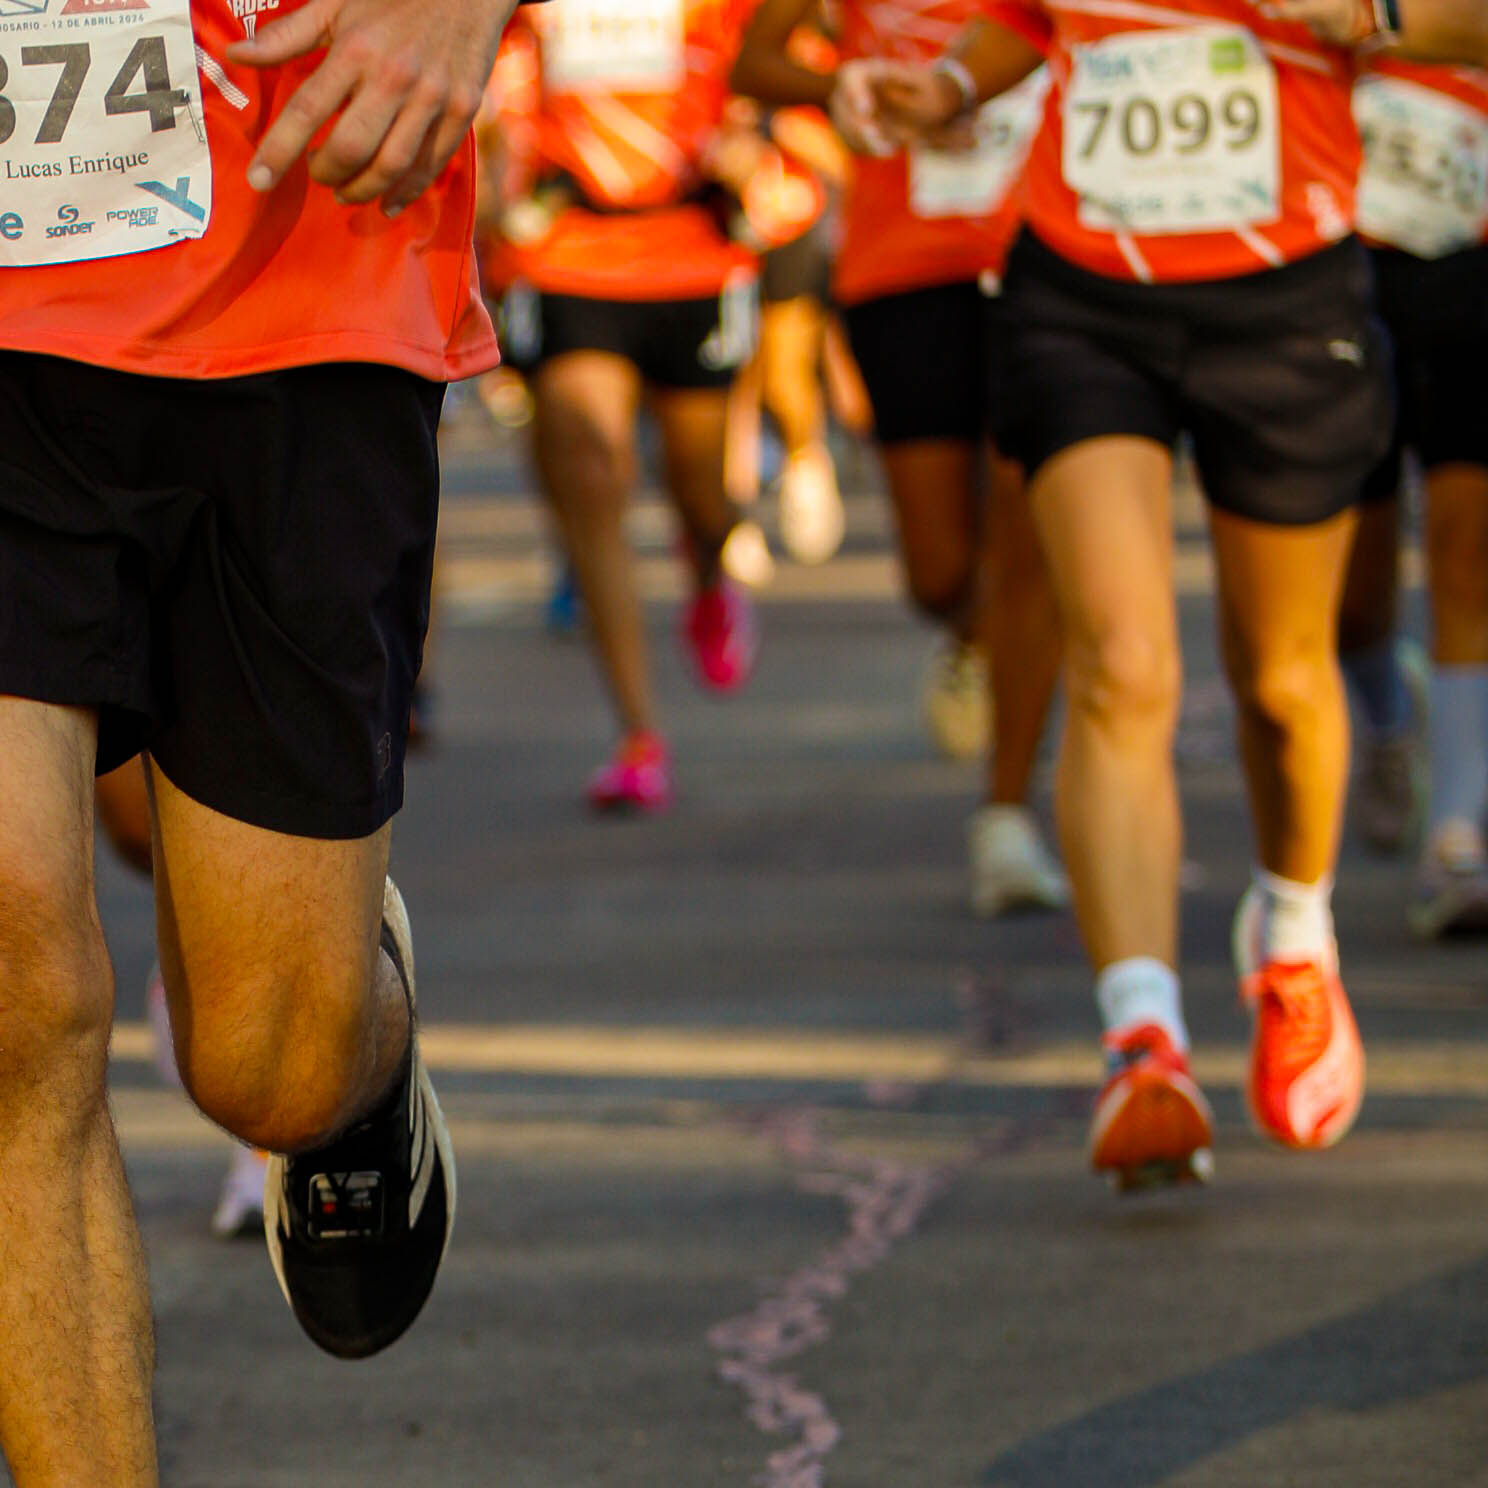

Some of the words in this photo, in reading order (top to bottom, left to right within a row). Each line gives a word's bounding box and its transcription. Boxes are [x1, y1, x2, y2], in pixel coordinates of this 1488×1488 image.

[67, 18, 80, 28] DE
[84, 16, 115, 27] ABRIL
[1072, 89, 1262, 162] 7099
[6, 160, 63, 179] Lucas
[69, 152, 150, 176] Enrique
[106, 207, 159, 222] POWER
